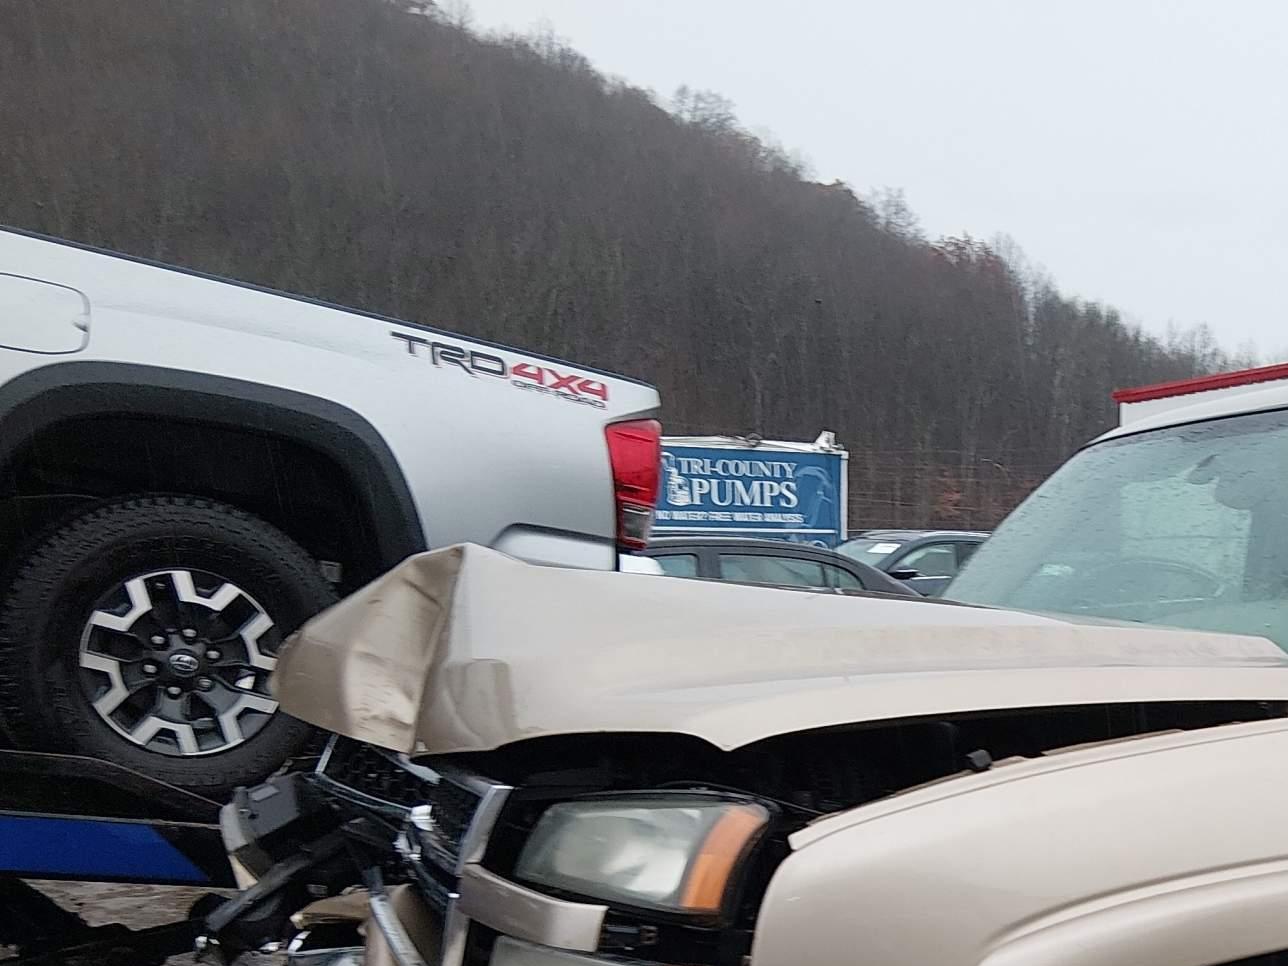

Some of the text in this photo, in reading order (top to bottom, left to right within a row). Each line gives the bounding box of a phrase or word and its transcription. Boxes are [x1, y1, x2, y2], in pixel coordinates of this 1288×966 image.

[390, 331, 610, 402] TRD 4X4
[677, 457, 798, 479] TRI-COUNTY
[690, 478, 799, 508] PUMPS
